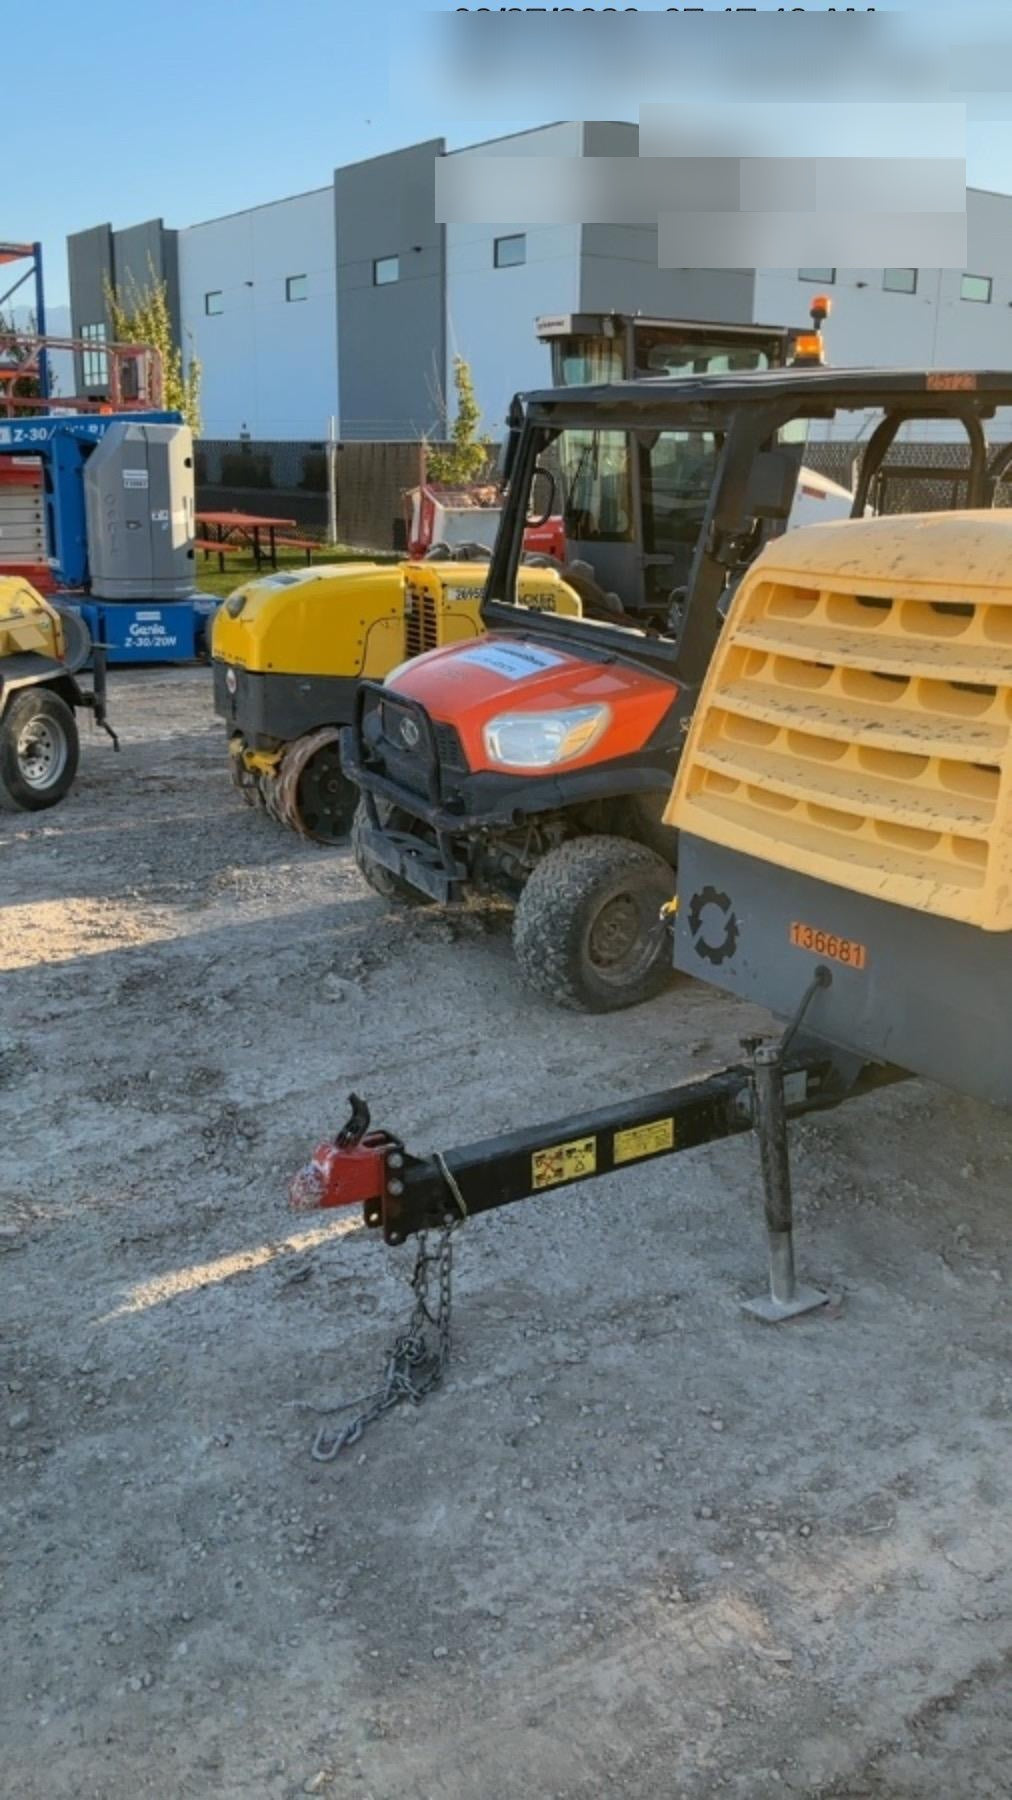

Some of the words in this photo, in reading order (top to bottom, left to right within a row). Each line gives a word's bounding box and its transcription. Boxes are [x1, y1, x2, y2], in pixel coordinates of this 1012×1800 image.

[519, 593, 556, 603] CKER
[129, 623, 168, 637] Genie
[124, 636, 177, 648] Z-30/20N
[792, 924, 863, 966] 136681
